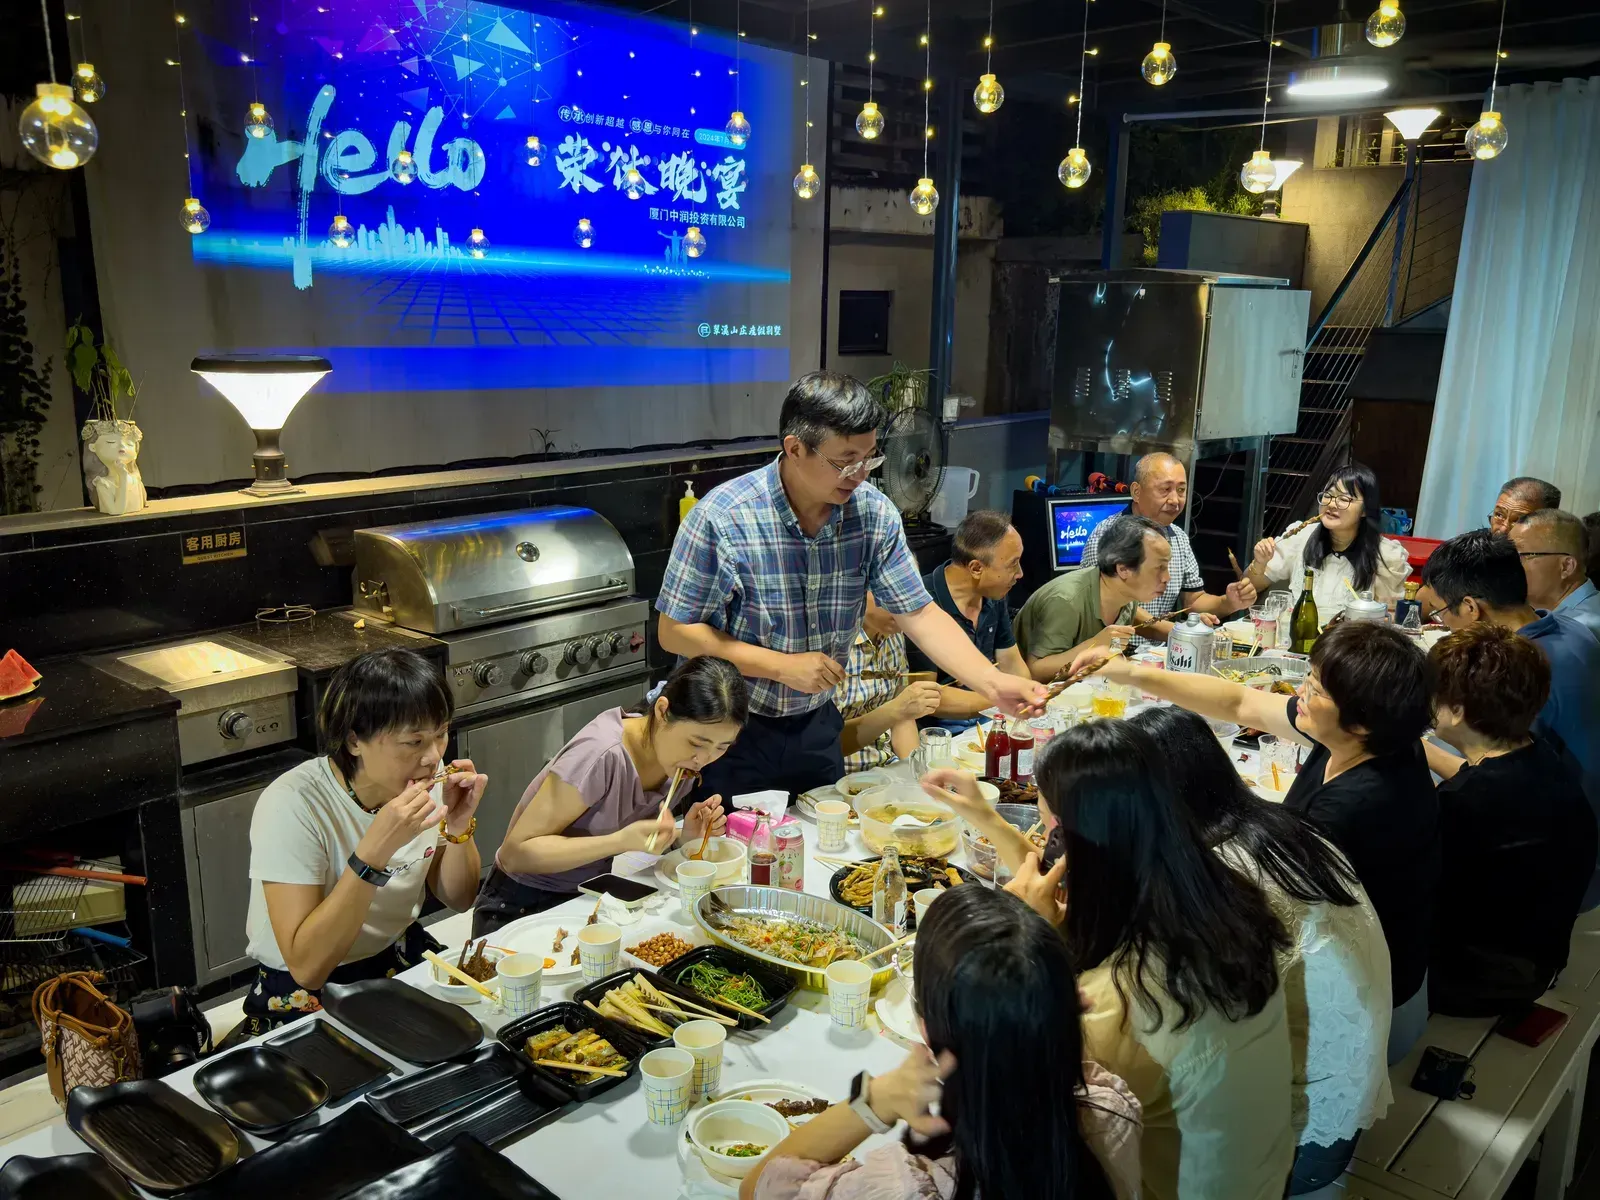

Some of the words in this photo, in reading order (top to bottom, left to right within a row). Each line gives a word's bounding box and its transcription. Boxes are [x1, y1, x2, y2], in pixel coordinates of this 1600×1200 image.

[558, 105, 625, 128] 传承创新超越
[630, 117, 690, 139] 感恩与你同在
[555, 132, 746, 210] 荣休晚宴
[236, 84, 486, 290] Hello
[649, 207, 746, 228] 厦门中润投资有限公司
[186, 531, 242, 552] 客用厨房
[1060, 524, 1088, 551] Hello
